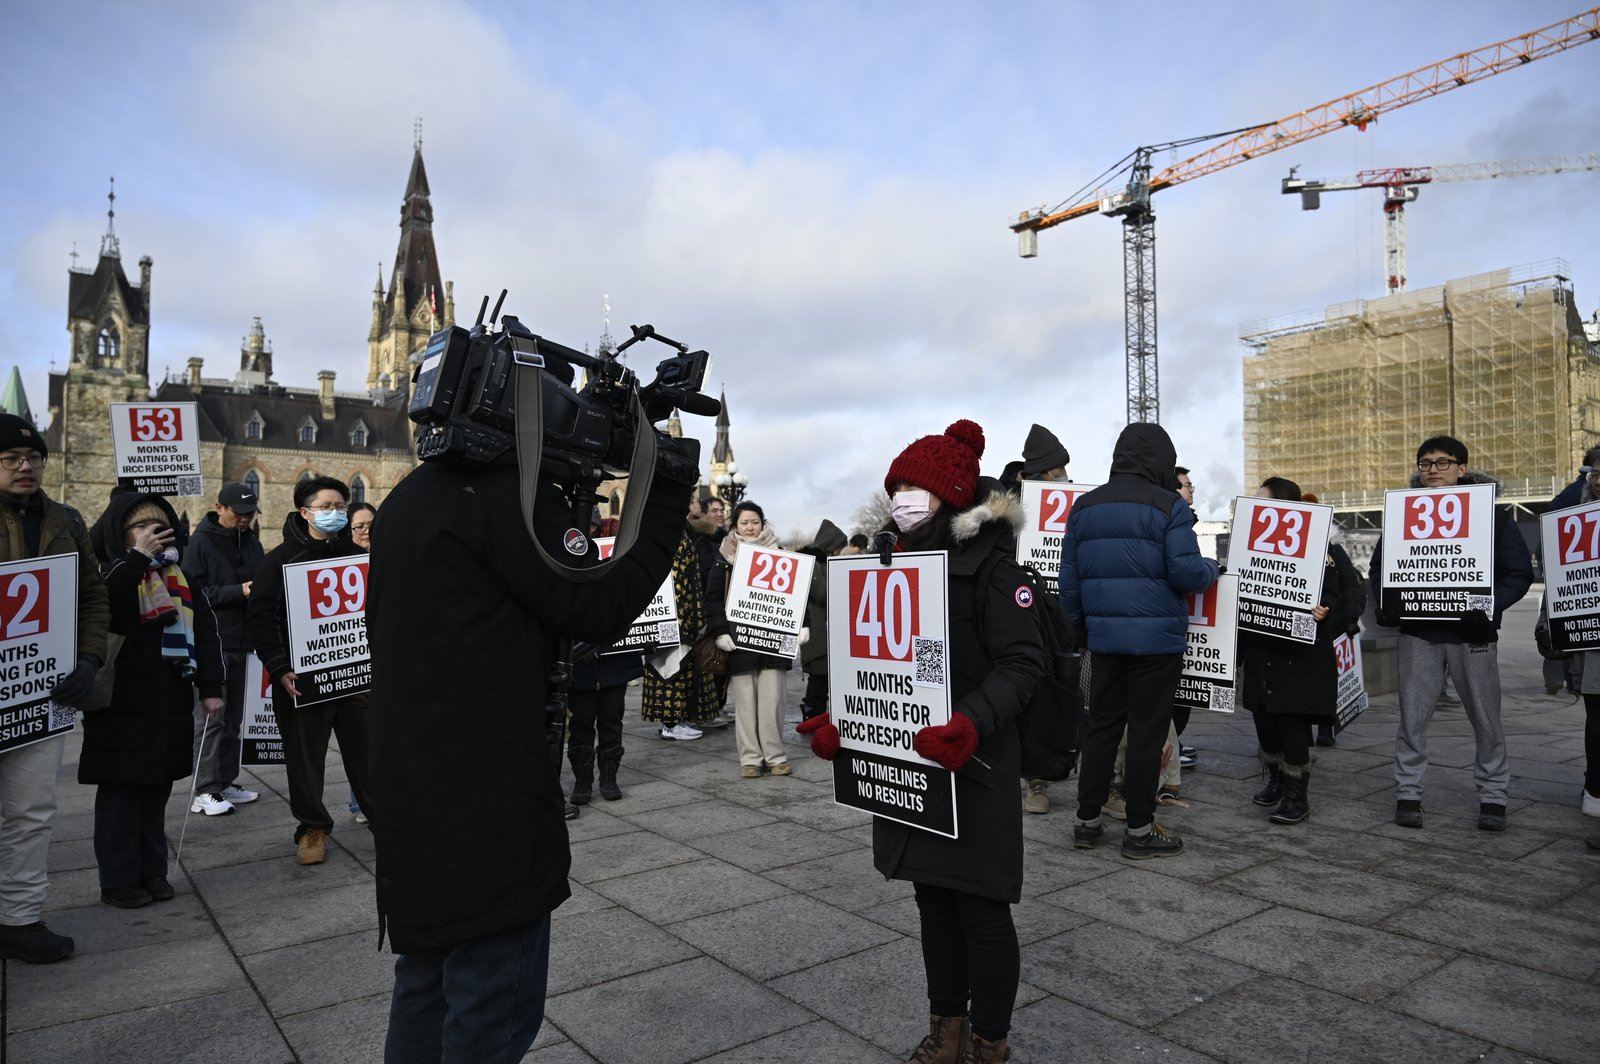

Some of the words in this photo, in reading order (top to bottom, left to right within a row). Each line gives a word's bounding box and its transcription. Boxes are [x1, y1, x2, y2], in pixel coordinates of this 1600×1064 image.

[587, 410, 606, 418] SONY
[137, 408, 176, 440] 53
[128, 455, 168, 463] WAITING
[146, 464, 195, 472] RESPONSE
[1044, 490, 1086, 531] 2
[1410, 494, 1462, 539] 39
[1254, 507, 1303, 556] 23
[1564, 510, 1600, 563] 27
[1410, 545, 1462, 556] MONTHS
[752, 553, 792, 592] 28
[1250, 557, 1296, 573] MONTHS
[1397, 559, 1447, 569] WAITING
[1452, 558, 1476, 568] FOR
[1238, 568, 1284, 584] WAITING
[1285, 576, 1307, 590] FOR
[1390, 572, 1415, 582] IRCC
[1418, 571, 1483, 582] RESPONSE
[316, 566, 365, 616] 39
[749, 591, 786, 605] MONTHS
[1254, 585, 1312, 604] RESPONSE
[1401, 592, 1414, 600] NO
[1417, 591, 1470, 600] TIMELINES
[1557, 582, 1598, 597] WAITING
[0, 572, 40, 638] 2
[639, 606, 670, 618] ONSE
[738, 600, 774, 613] WAITING
[776, 607, 793, 618] FOR
[1239, 601, 1249, 610] NO
[1405, 602, 1419, 611] NO
[1422, 602, 1465, 611] RESULTS
[1553, 600, 1574, 612] IRCC
[731, 609, 749, 619] IRCC
[750, 613, 796, 629] RESPONSE
[856, 569, 911, 660] 40
[1240, 612, 1252, 622] NO
[1254, 615, 1292, 631] RESULTS
[319, 617, 366, 635] MONTHS
[736, 626, 746, 634] NO
[748, 627, 785, 640] TIMELINES
[1565, 620, 1575, 630] NO
[307, 633, 356, 651] WAITING
[626, 634, 660, 645] RESULTS
[737, 635, 748, 643] NO
[749, 637, 780, 649] RESULTS
[1569, 633, 1580, 642] NO
[1582, 630, 1600, 641] RES
[301, 652, 327, 667] IRCC
[329, 644, 370, 661] RESPO
[1197, 647, 1220, 659] FOR
[1336, 638, 1353, 675] 34
[25, 657, 56, 676] FOR
[314, 673, 328, 683] NO
[857, 670, 913, 696] MONTHS
[320, 684, 333, 694] NO
[0, 703, 49, 726] ELINES
[844, 694, 898, 721] WAITING
[902, 702, 930, 726] FOR
[0, 719, 43, 741] SULTS
[249, 726, 267, 734] IRCC
[839, 719, 865, 741] IRCC
[852, 758, 866, 776] NO
[868, 762, 927, 791] TIMELINES
[858, 780, 872, 798] NO
[875, 785, 923, 812] RESULTS
